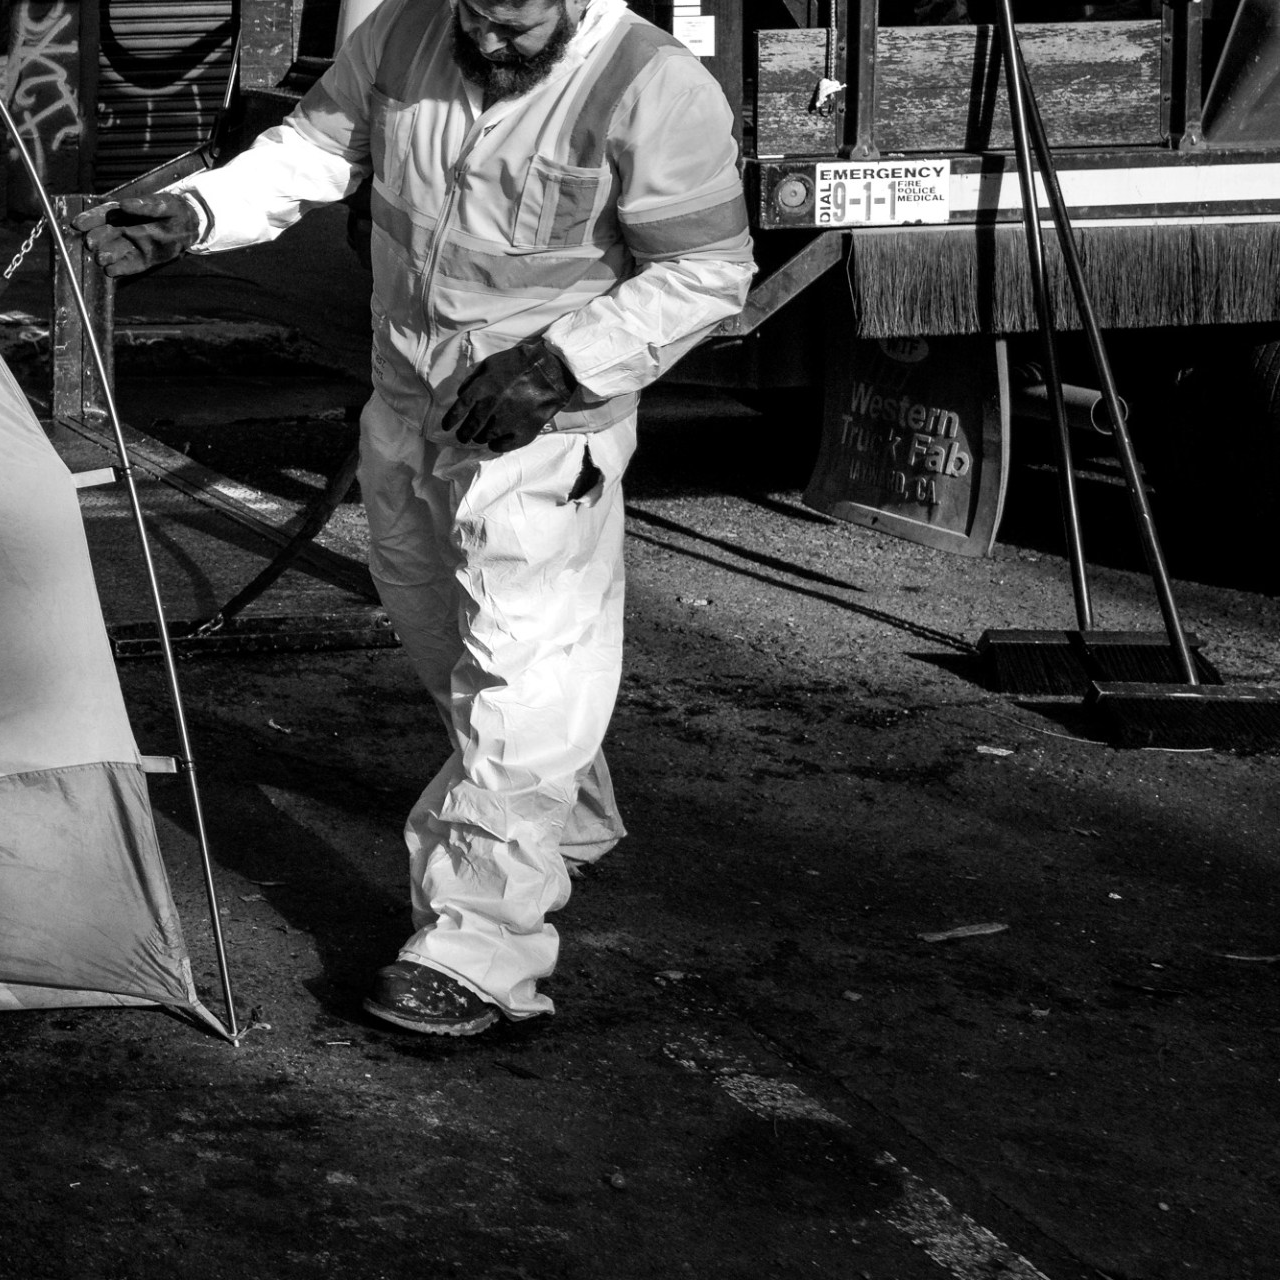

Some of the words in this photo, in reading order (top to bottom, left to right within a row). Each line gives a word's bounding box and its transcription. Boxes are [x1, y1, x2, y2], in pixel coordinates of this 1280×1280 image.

[819, 166, 945, 181] EMERGENCY
[819, 183, 832, 224] DIAL
[832, 181, 897, 222] 9-1-1
[897, 186, 937, 195] POLICE
[897, 194, 946, 202] MEDICAL
[850, 381, 961, 439] Western
[907, 432, 971, 478] Fab
